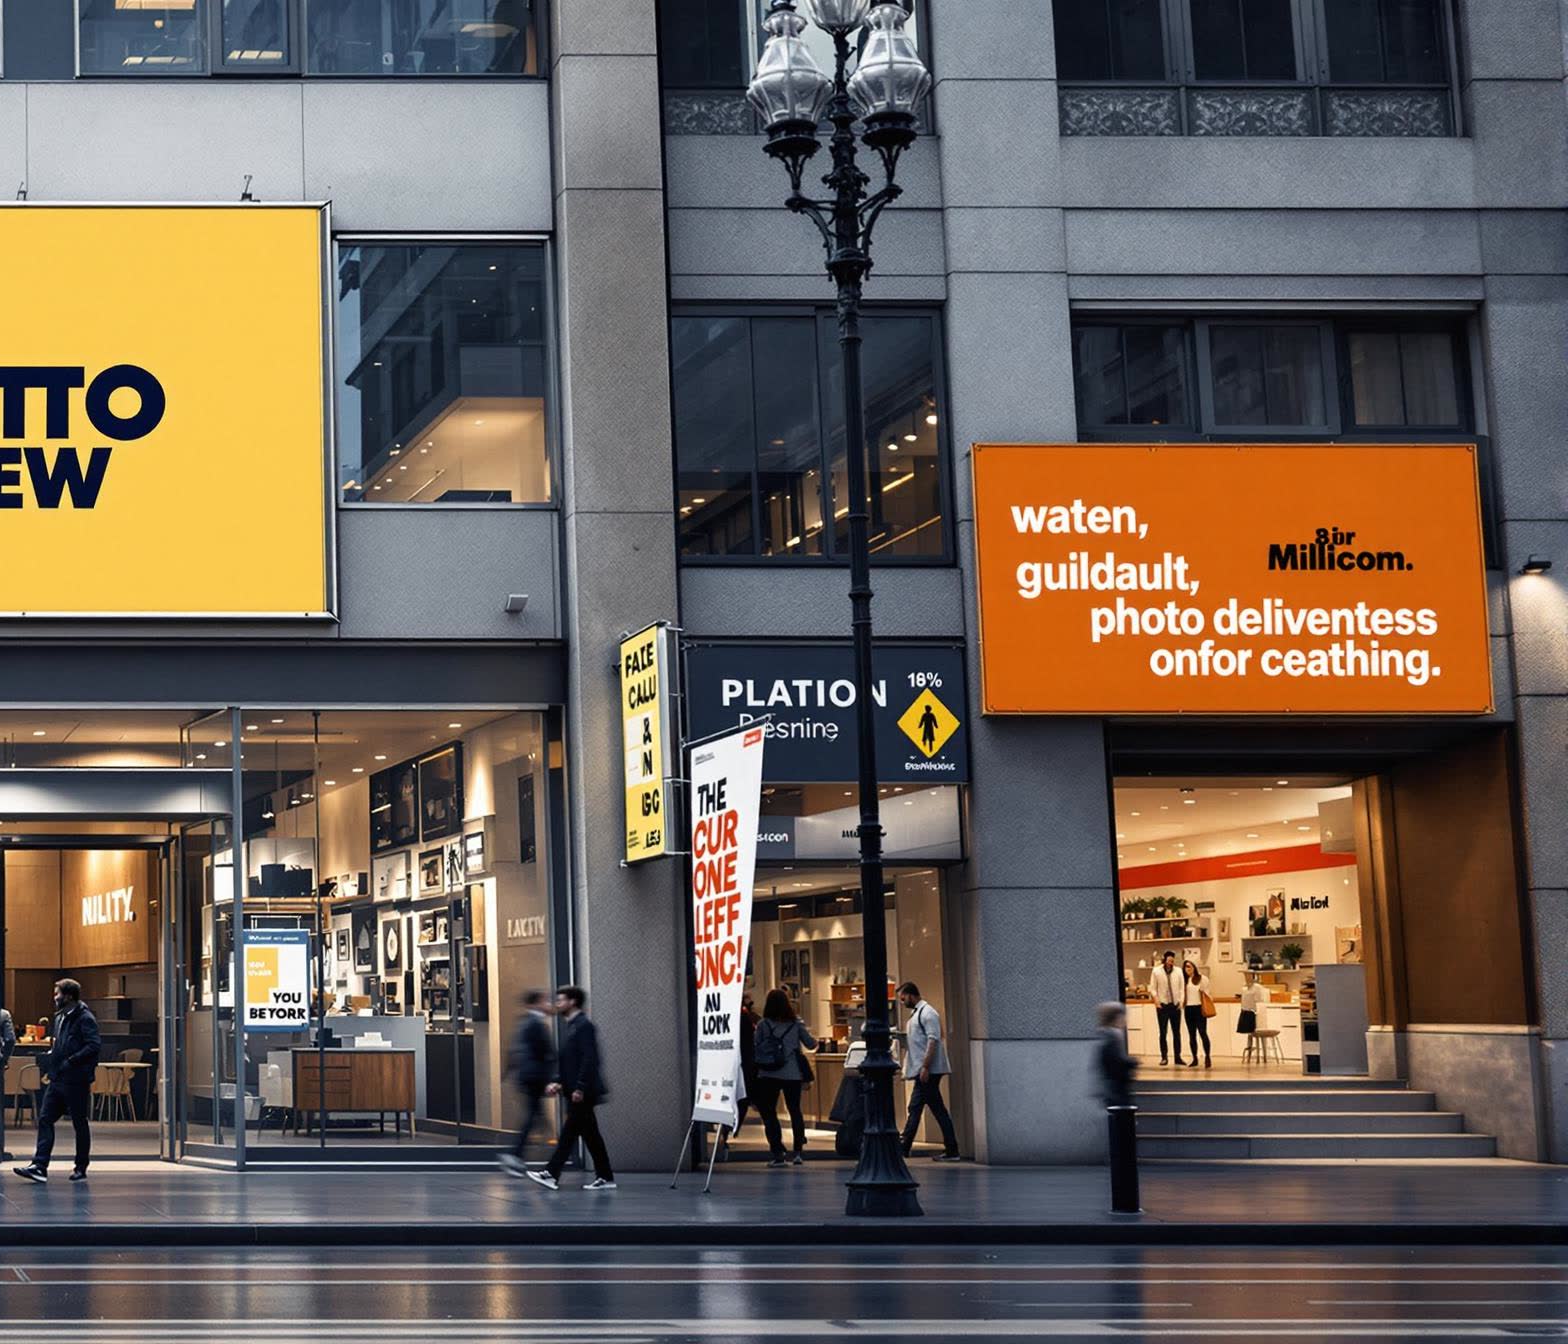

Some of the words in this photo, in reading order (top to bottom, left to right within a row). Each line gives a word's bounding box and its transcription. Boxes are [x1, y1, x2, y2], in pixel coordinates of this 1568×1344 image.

[1010, 499, 1149, 540] waten,
[1016, 552, 1200, 599] guildault,
[1268, 543, 1413, 571] Millicom.
[1091, 597, 1205, 643] photo
[1213, 598, 1438, 636] deliventess
[907, 672, 943, 688] 18%
[1149, 640, 1253, 677] onfor
[1260, 640, 1441, 686] ceathing.
[722, 679, 887, 708] PLATION
[698, 777, 727, 817] THE
[694, 809, 738, 859] CUR
[694, 851, 738, 899] ONE
[272, 992, 302, 1004] YOU
